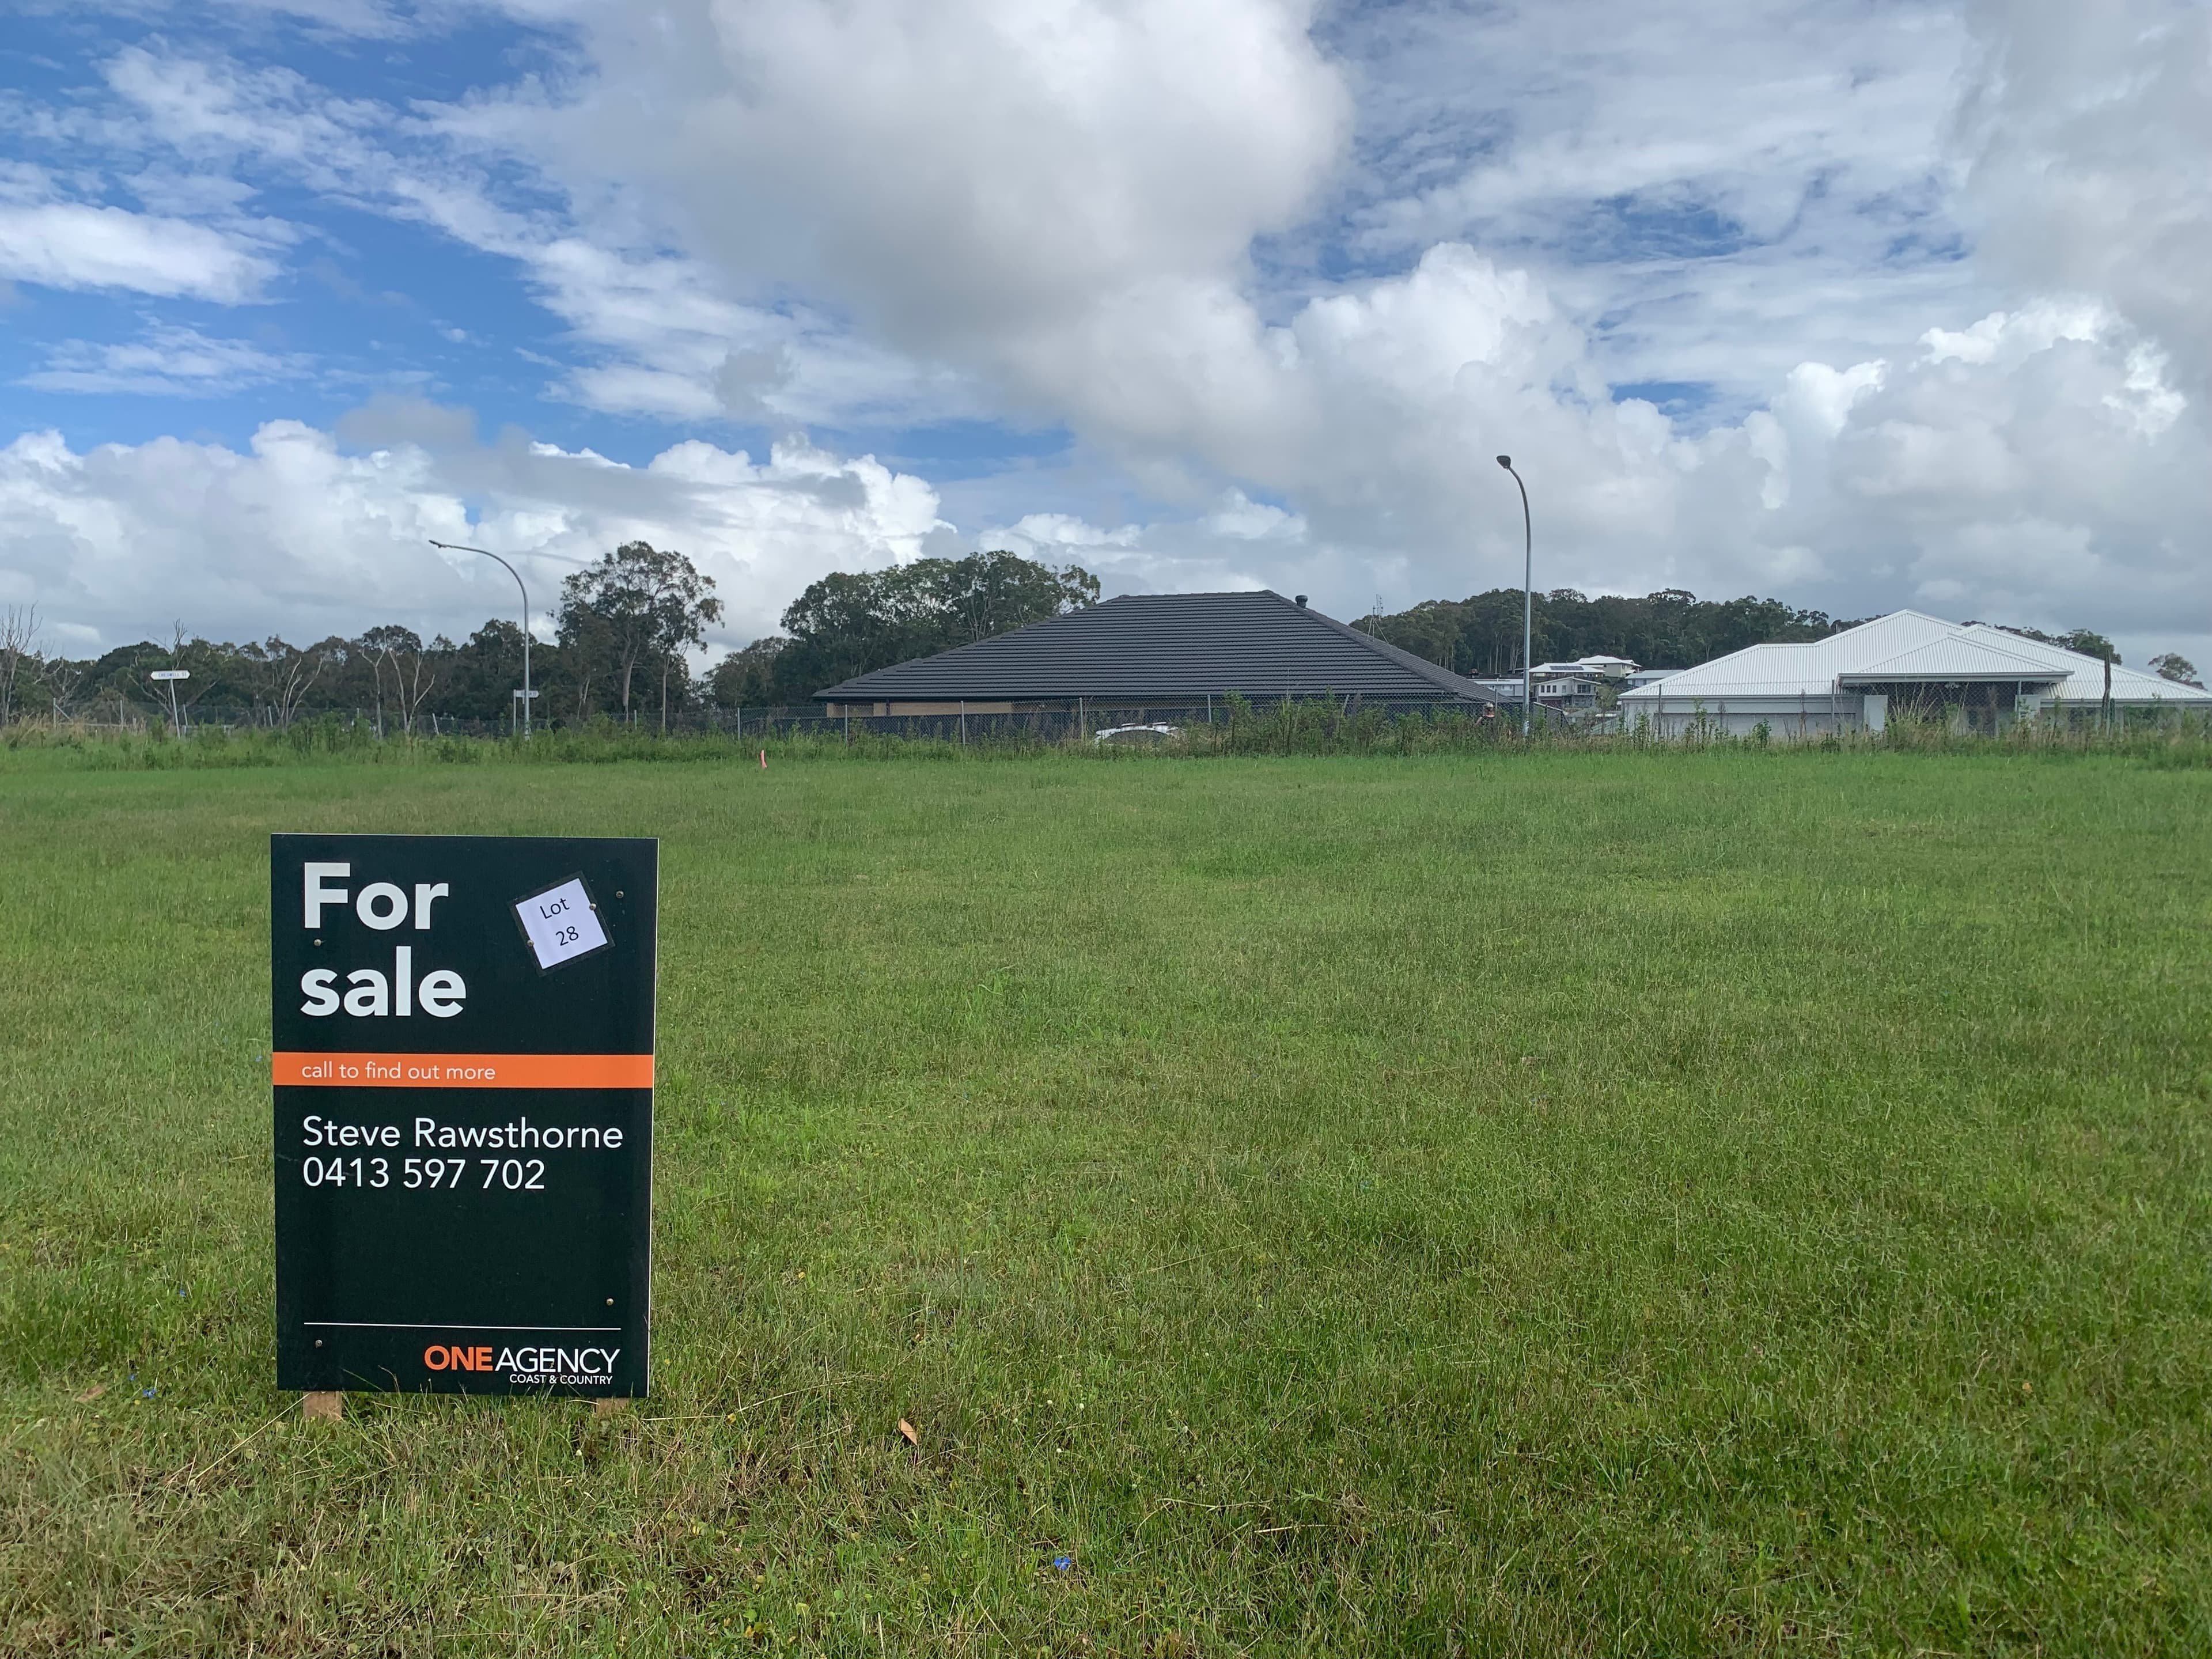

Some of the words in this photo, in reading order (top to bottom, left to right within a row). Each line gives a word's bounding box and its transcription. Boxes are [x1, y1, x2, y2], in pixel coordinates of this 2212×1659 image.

[304, 862, 449, 930] For
[540, 897, 570, 920] Lot
[555, 926, 579, 946] 28
[301, 946, 467, 1017] sale
[302, 1061, 332, 1078] call
[339, 1065, 359, 1078] to
[365, 1061, 401, 1079] find
[408, 1065, 440, 1080] out
[446, 1067, 495, 1080] more
[303, 1115, 400, 1147] Steve
[415, 1116, 623, 1149] Rawsthorne
[303, 1157, 389, 1188] 0413
[403, 1158, 466, 1188] 597
[480, 1159, 544, 1190] 702
[509, 1374, 547, 1384] COAST
[548, 1374, 557, 1384] &
[559, 1374, 613, 1385] COUNTRY
